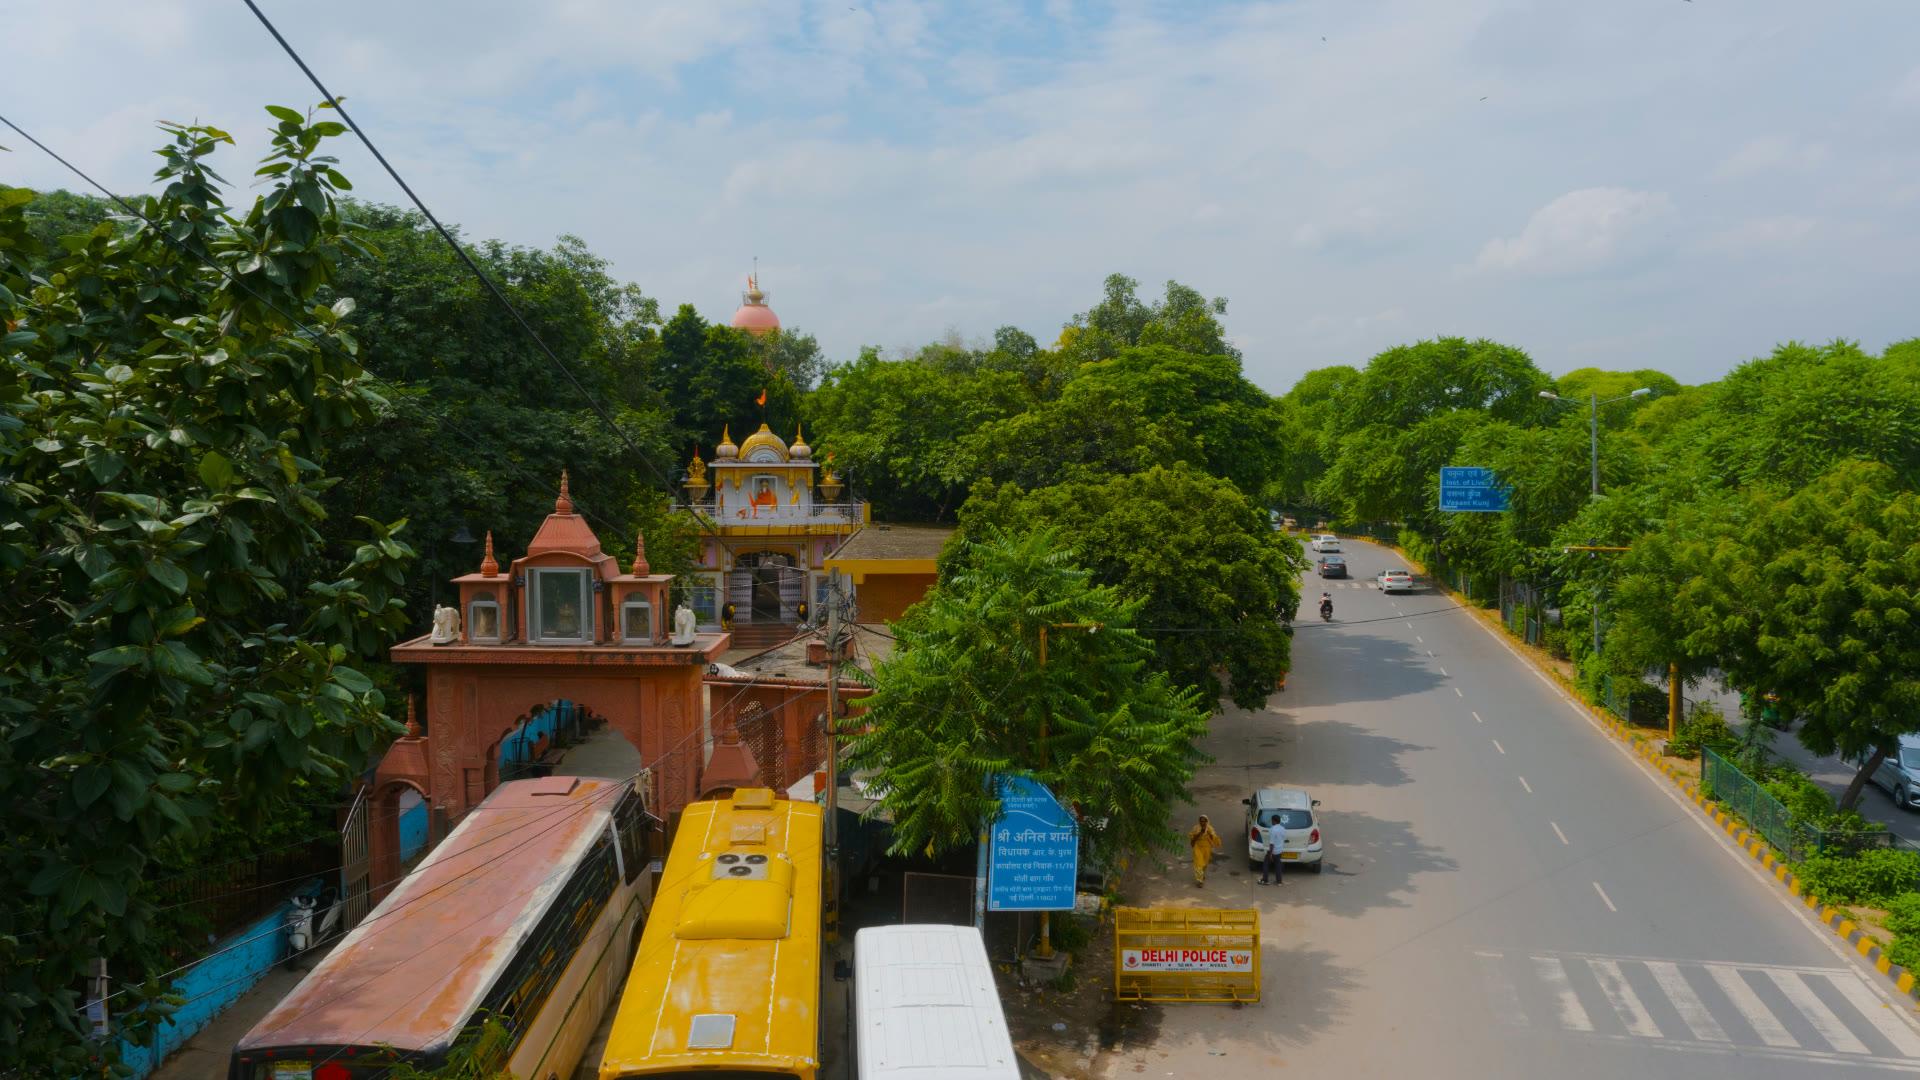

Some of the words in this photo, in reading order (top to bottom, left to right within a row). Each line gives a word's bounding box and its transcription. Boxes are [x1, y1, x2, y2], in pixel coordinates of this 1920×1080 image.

[998, 828, 1010, 843] श्री
[1013, 828, 1046, 843] अनिल
[998, 846, 1032, 856] विधायक
[1142, 950, 1178, 962] DELHI
[1182, 950, 1227, 962] POLICE
